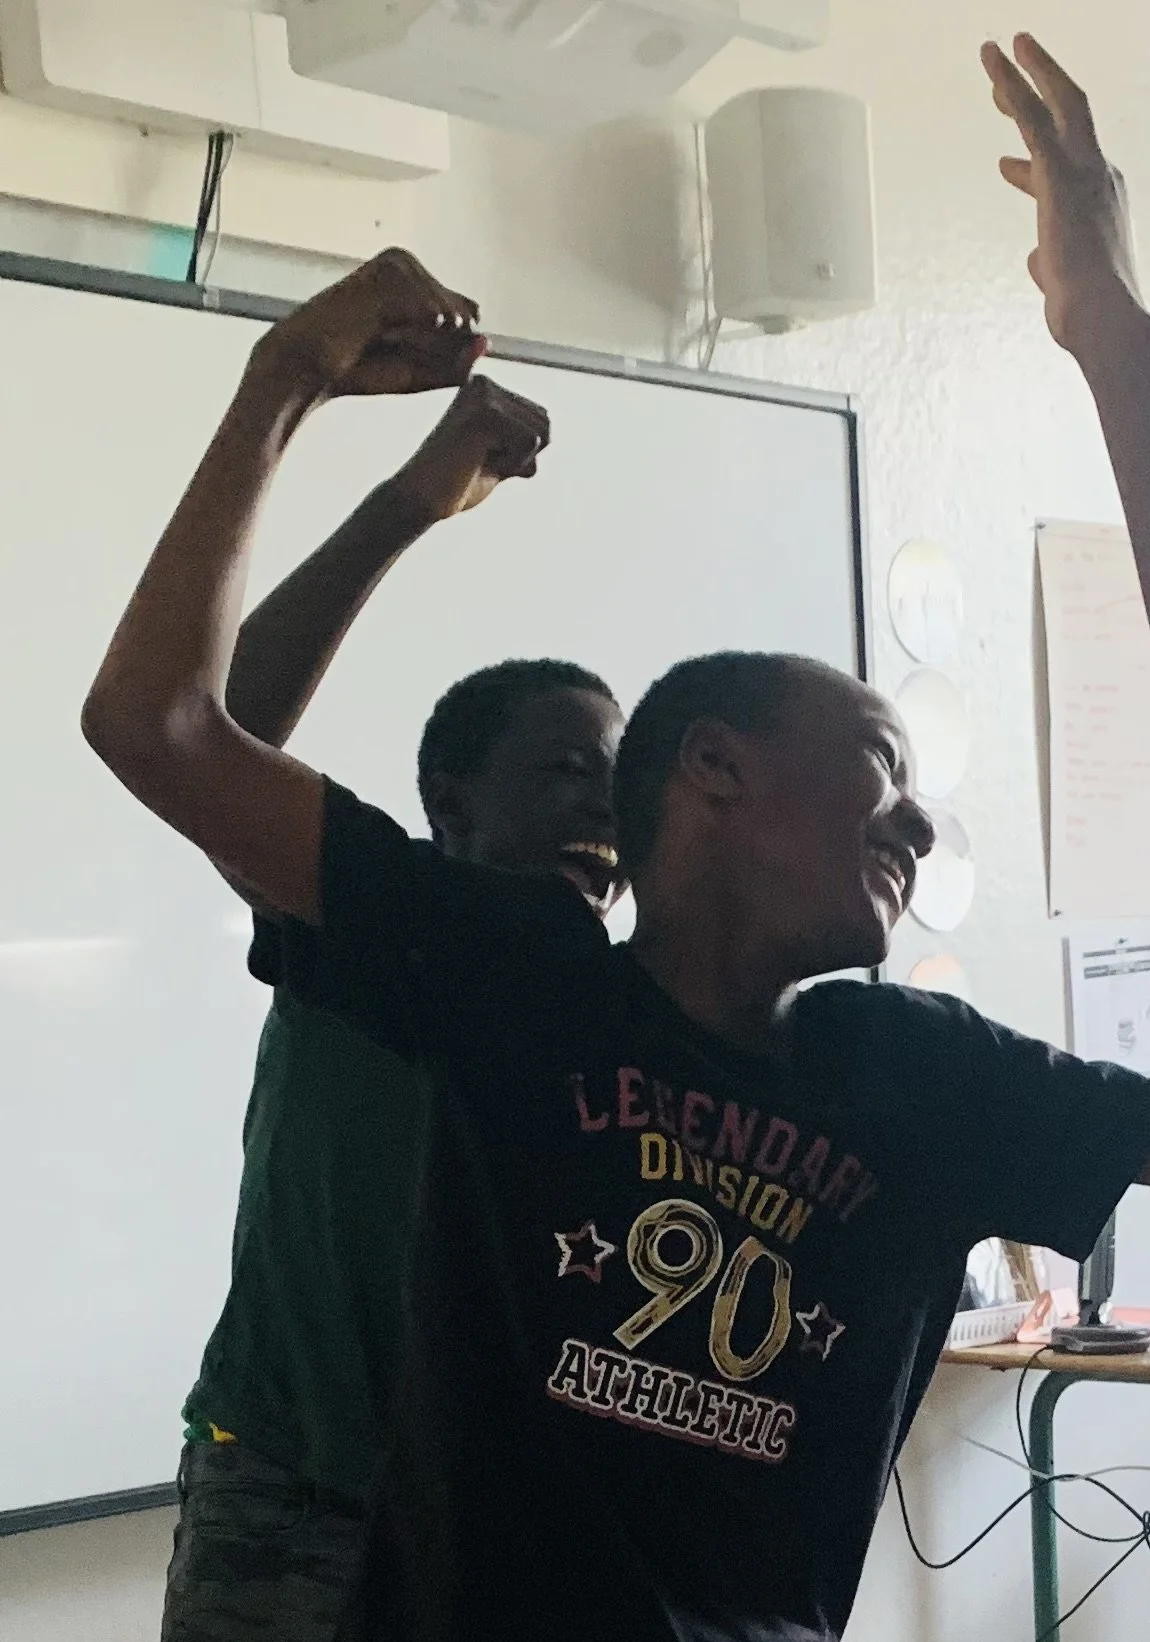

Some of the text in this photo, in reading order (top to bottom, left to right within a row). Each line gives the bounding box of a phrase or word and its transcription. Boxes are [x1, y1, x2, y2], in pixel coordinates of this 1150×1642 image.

[640, 1132, 814, 1243] DIVISION
[612, 1198, 792, 1381] 90
[547, 1338, 795, 1462] ATHLETIC
